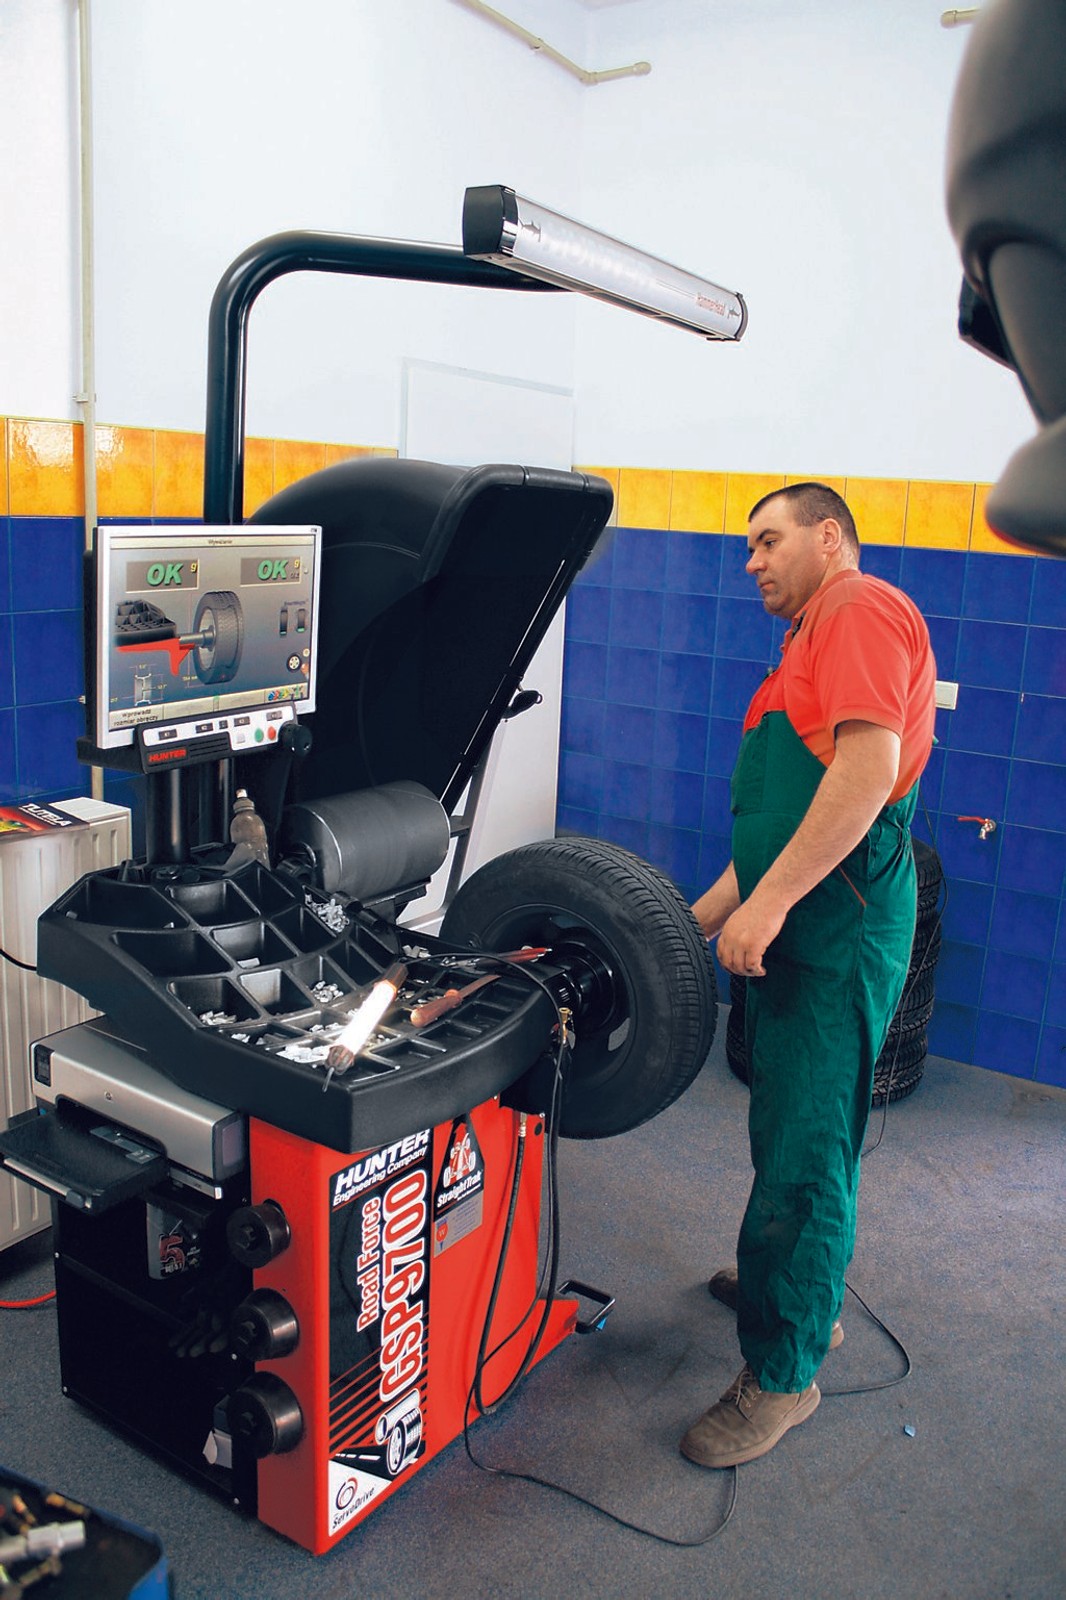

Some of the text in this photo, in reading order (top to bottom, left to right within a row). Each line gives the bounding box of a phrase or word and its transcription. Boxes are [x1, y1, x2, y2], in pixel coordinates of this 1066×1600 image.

[146, 562, 183, 587] OK
[257, 559, 289, 581] OK
[149, 748, 187, 762] HUNTER
[22, 803, 73, 827] TUTELA
[332, 1145, 428, 1207] Engineering Company
[335, 1128, 431, 1195] HUNTER
[356, 1196, 381, 1332] Road Force
[379, 1169, 427, 1402] GSP9700
[331, 1486, 375, 1530] ServoDrive
